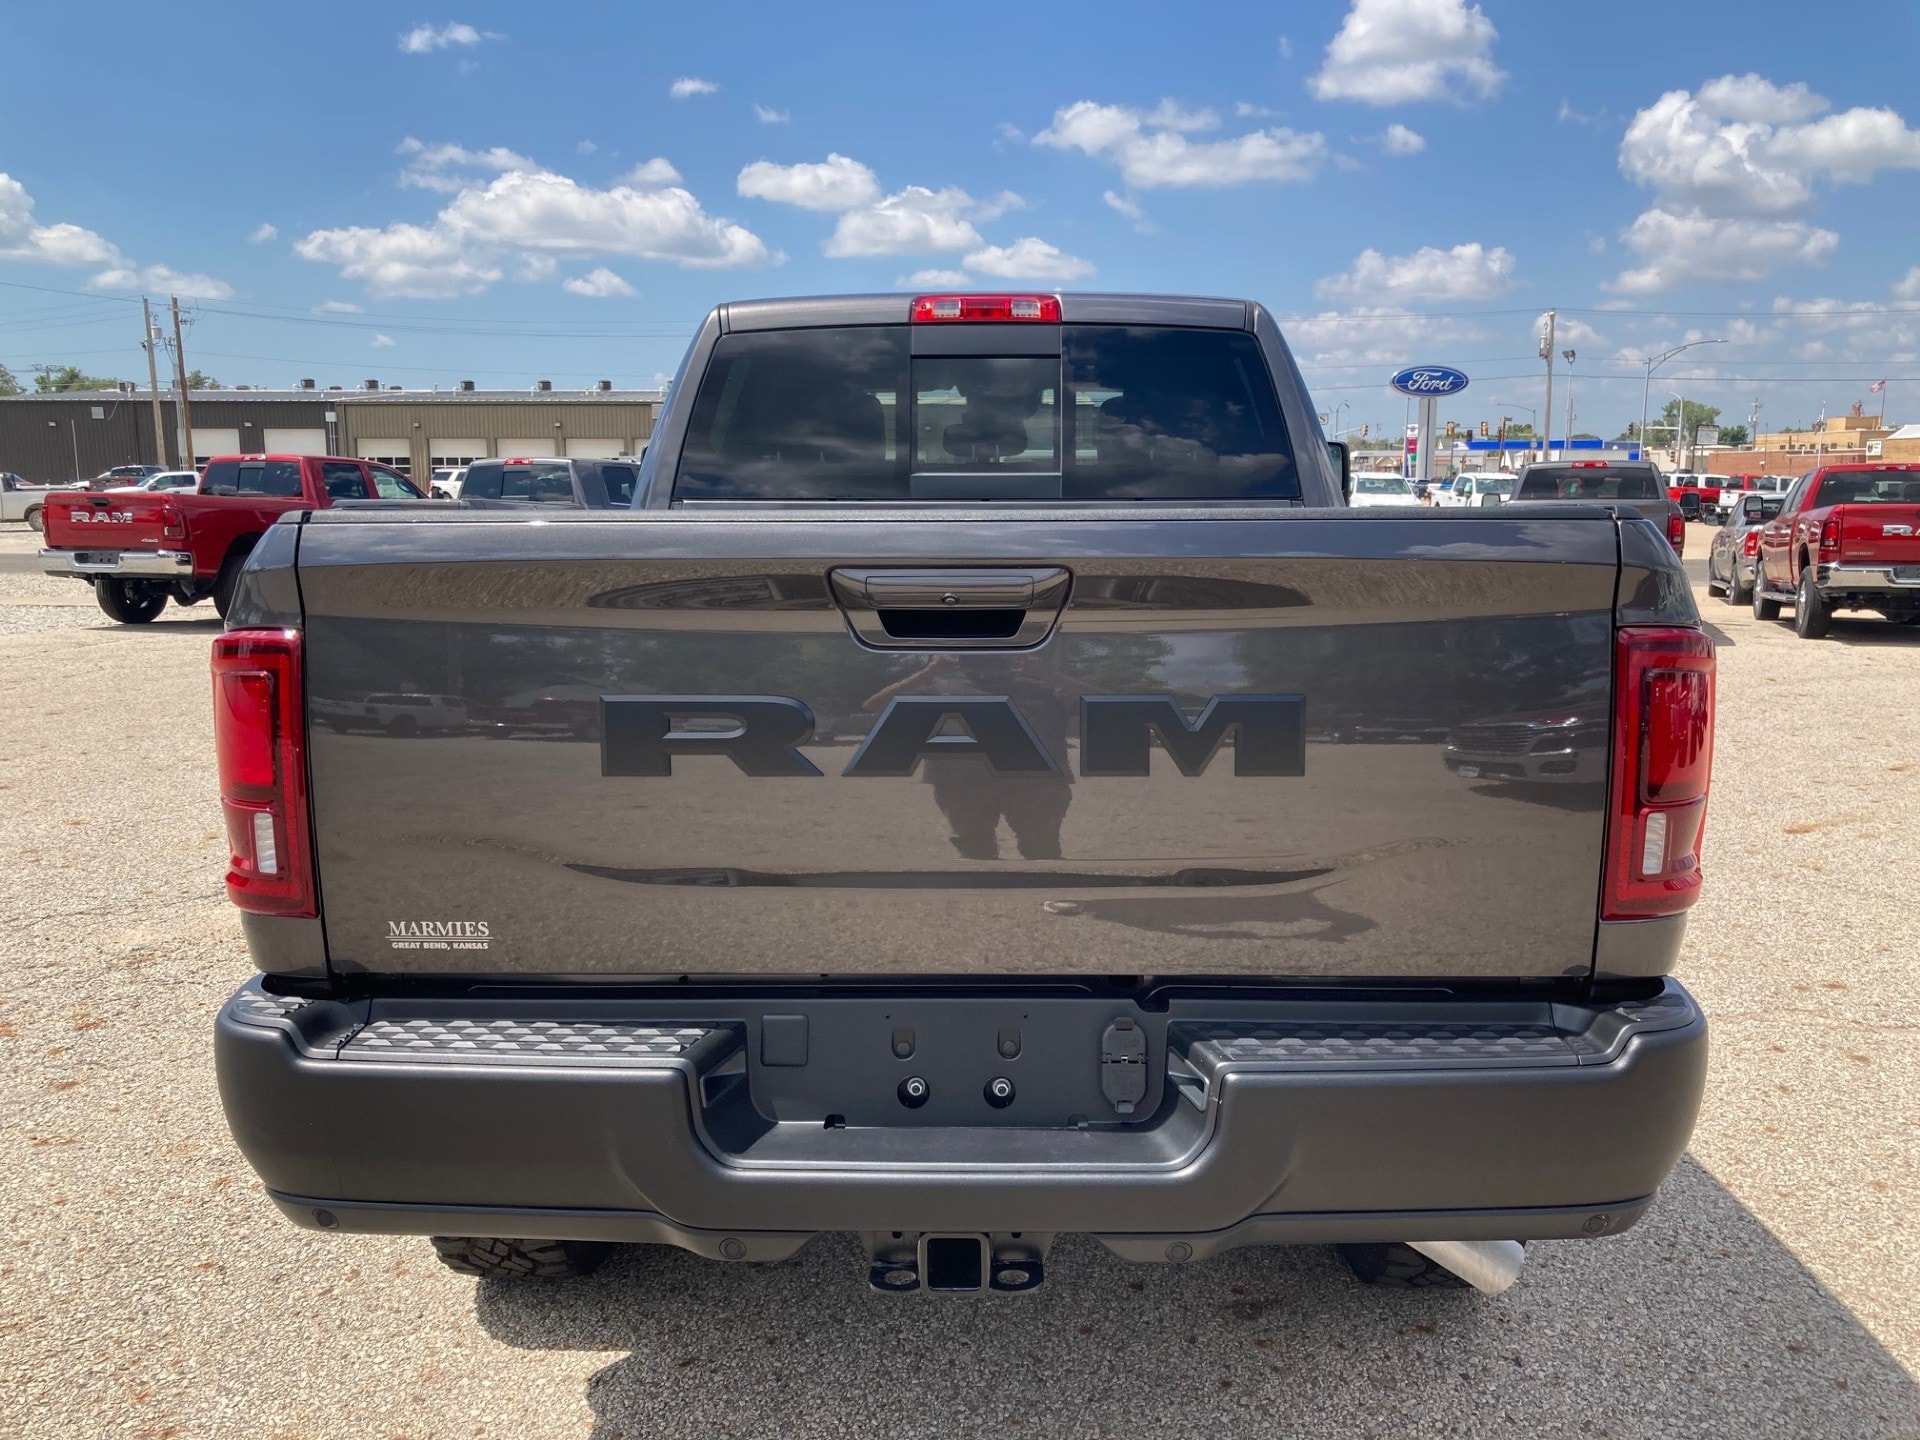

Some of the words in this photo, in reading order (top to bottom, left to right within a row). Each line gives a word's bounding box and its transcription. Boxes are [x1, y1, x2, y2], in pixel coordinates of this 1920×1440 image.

[1408, 371, 1454, 390] Ford
[70, 511, 133, 524] RAM
[600, 694, 1306, 777] RAM
[388, 921, 490, 937] MARMIES
[391, 941, 421, 949] GREAT
[423, 942, 451, 951] BEND,
[452, 942, 489, 950] KANSAS
